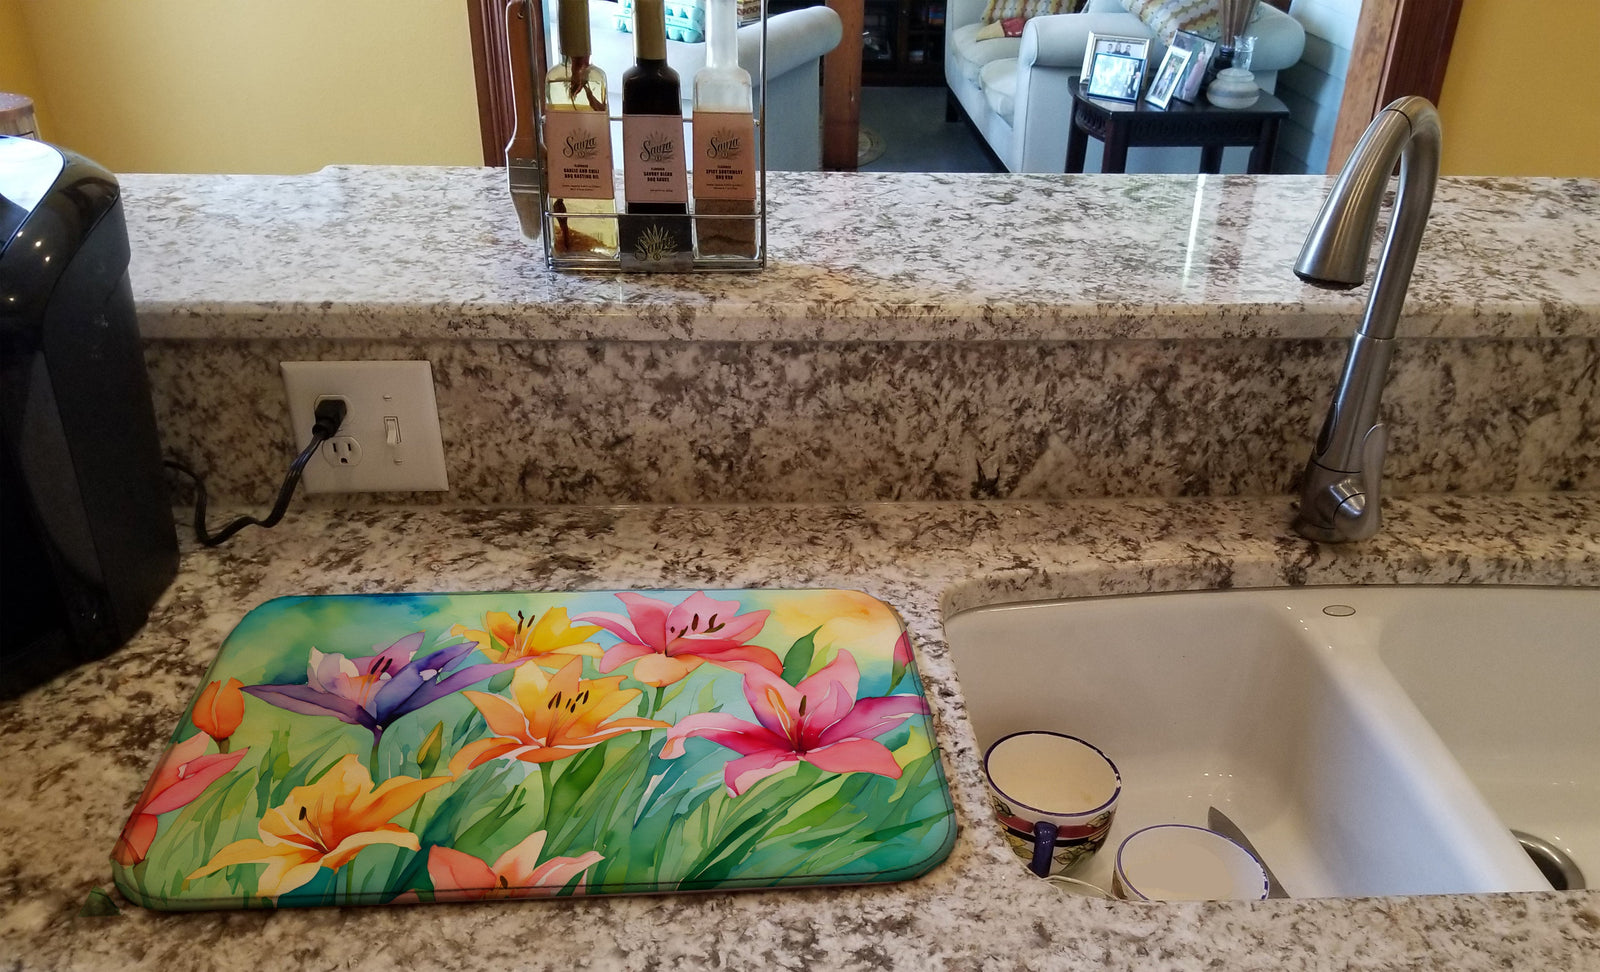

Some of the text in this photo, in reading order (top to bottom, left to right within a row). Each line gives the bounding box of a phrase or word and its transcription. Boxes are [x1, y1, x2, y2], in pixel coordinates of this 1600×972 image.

[562, 136, 598, 158] Sauza
[639, 140, 674, 162] Sauza
[706, 136, 741, 159] Sauza
